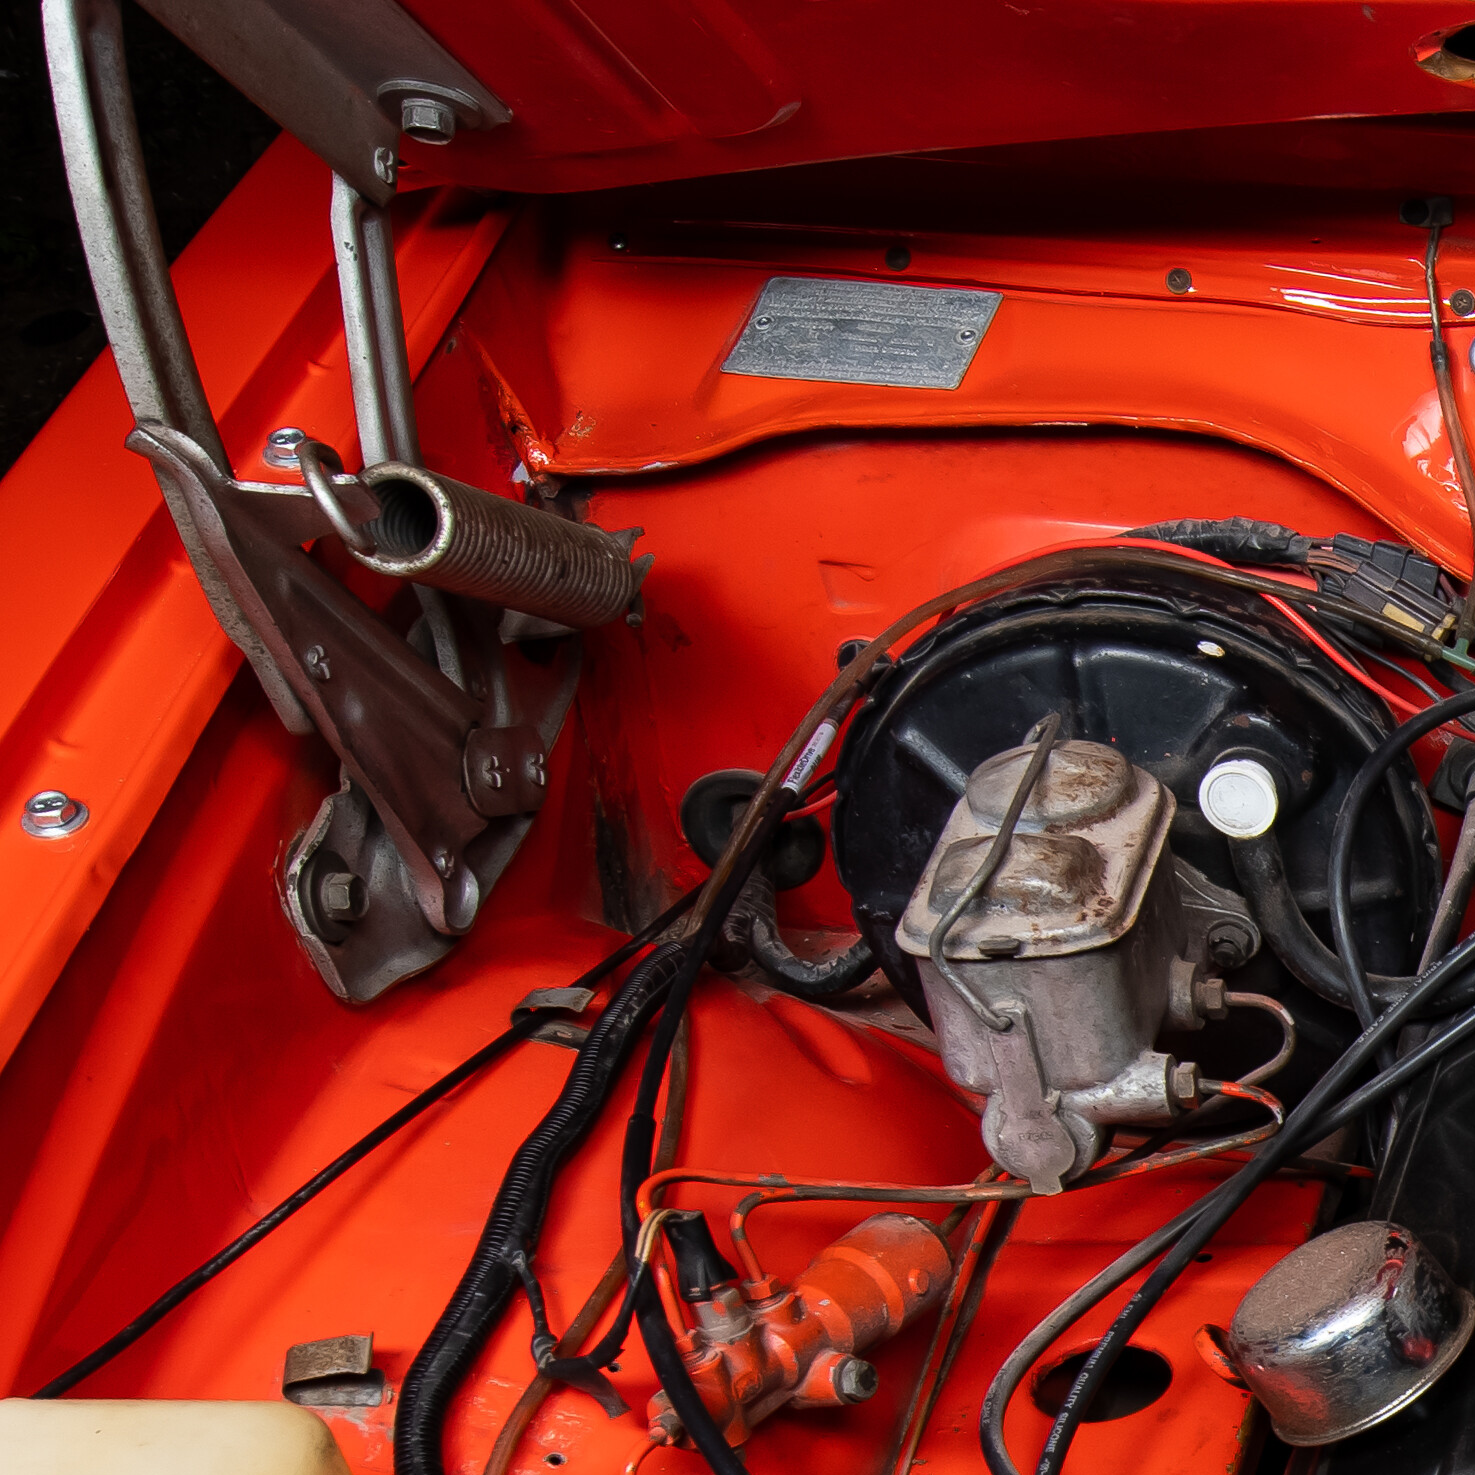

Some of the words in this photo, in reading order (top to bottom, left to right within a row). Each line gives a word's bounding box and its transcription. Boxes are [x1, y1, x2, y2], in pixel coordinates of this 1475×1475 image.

[1085, 1330, 1115, 1369] PREMIUM
[1064, 1371, 1089, 1409] QUALITY
[1045, 1412, 1069, 1453] SILICONE
